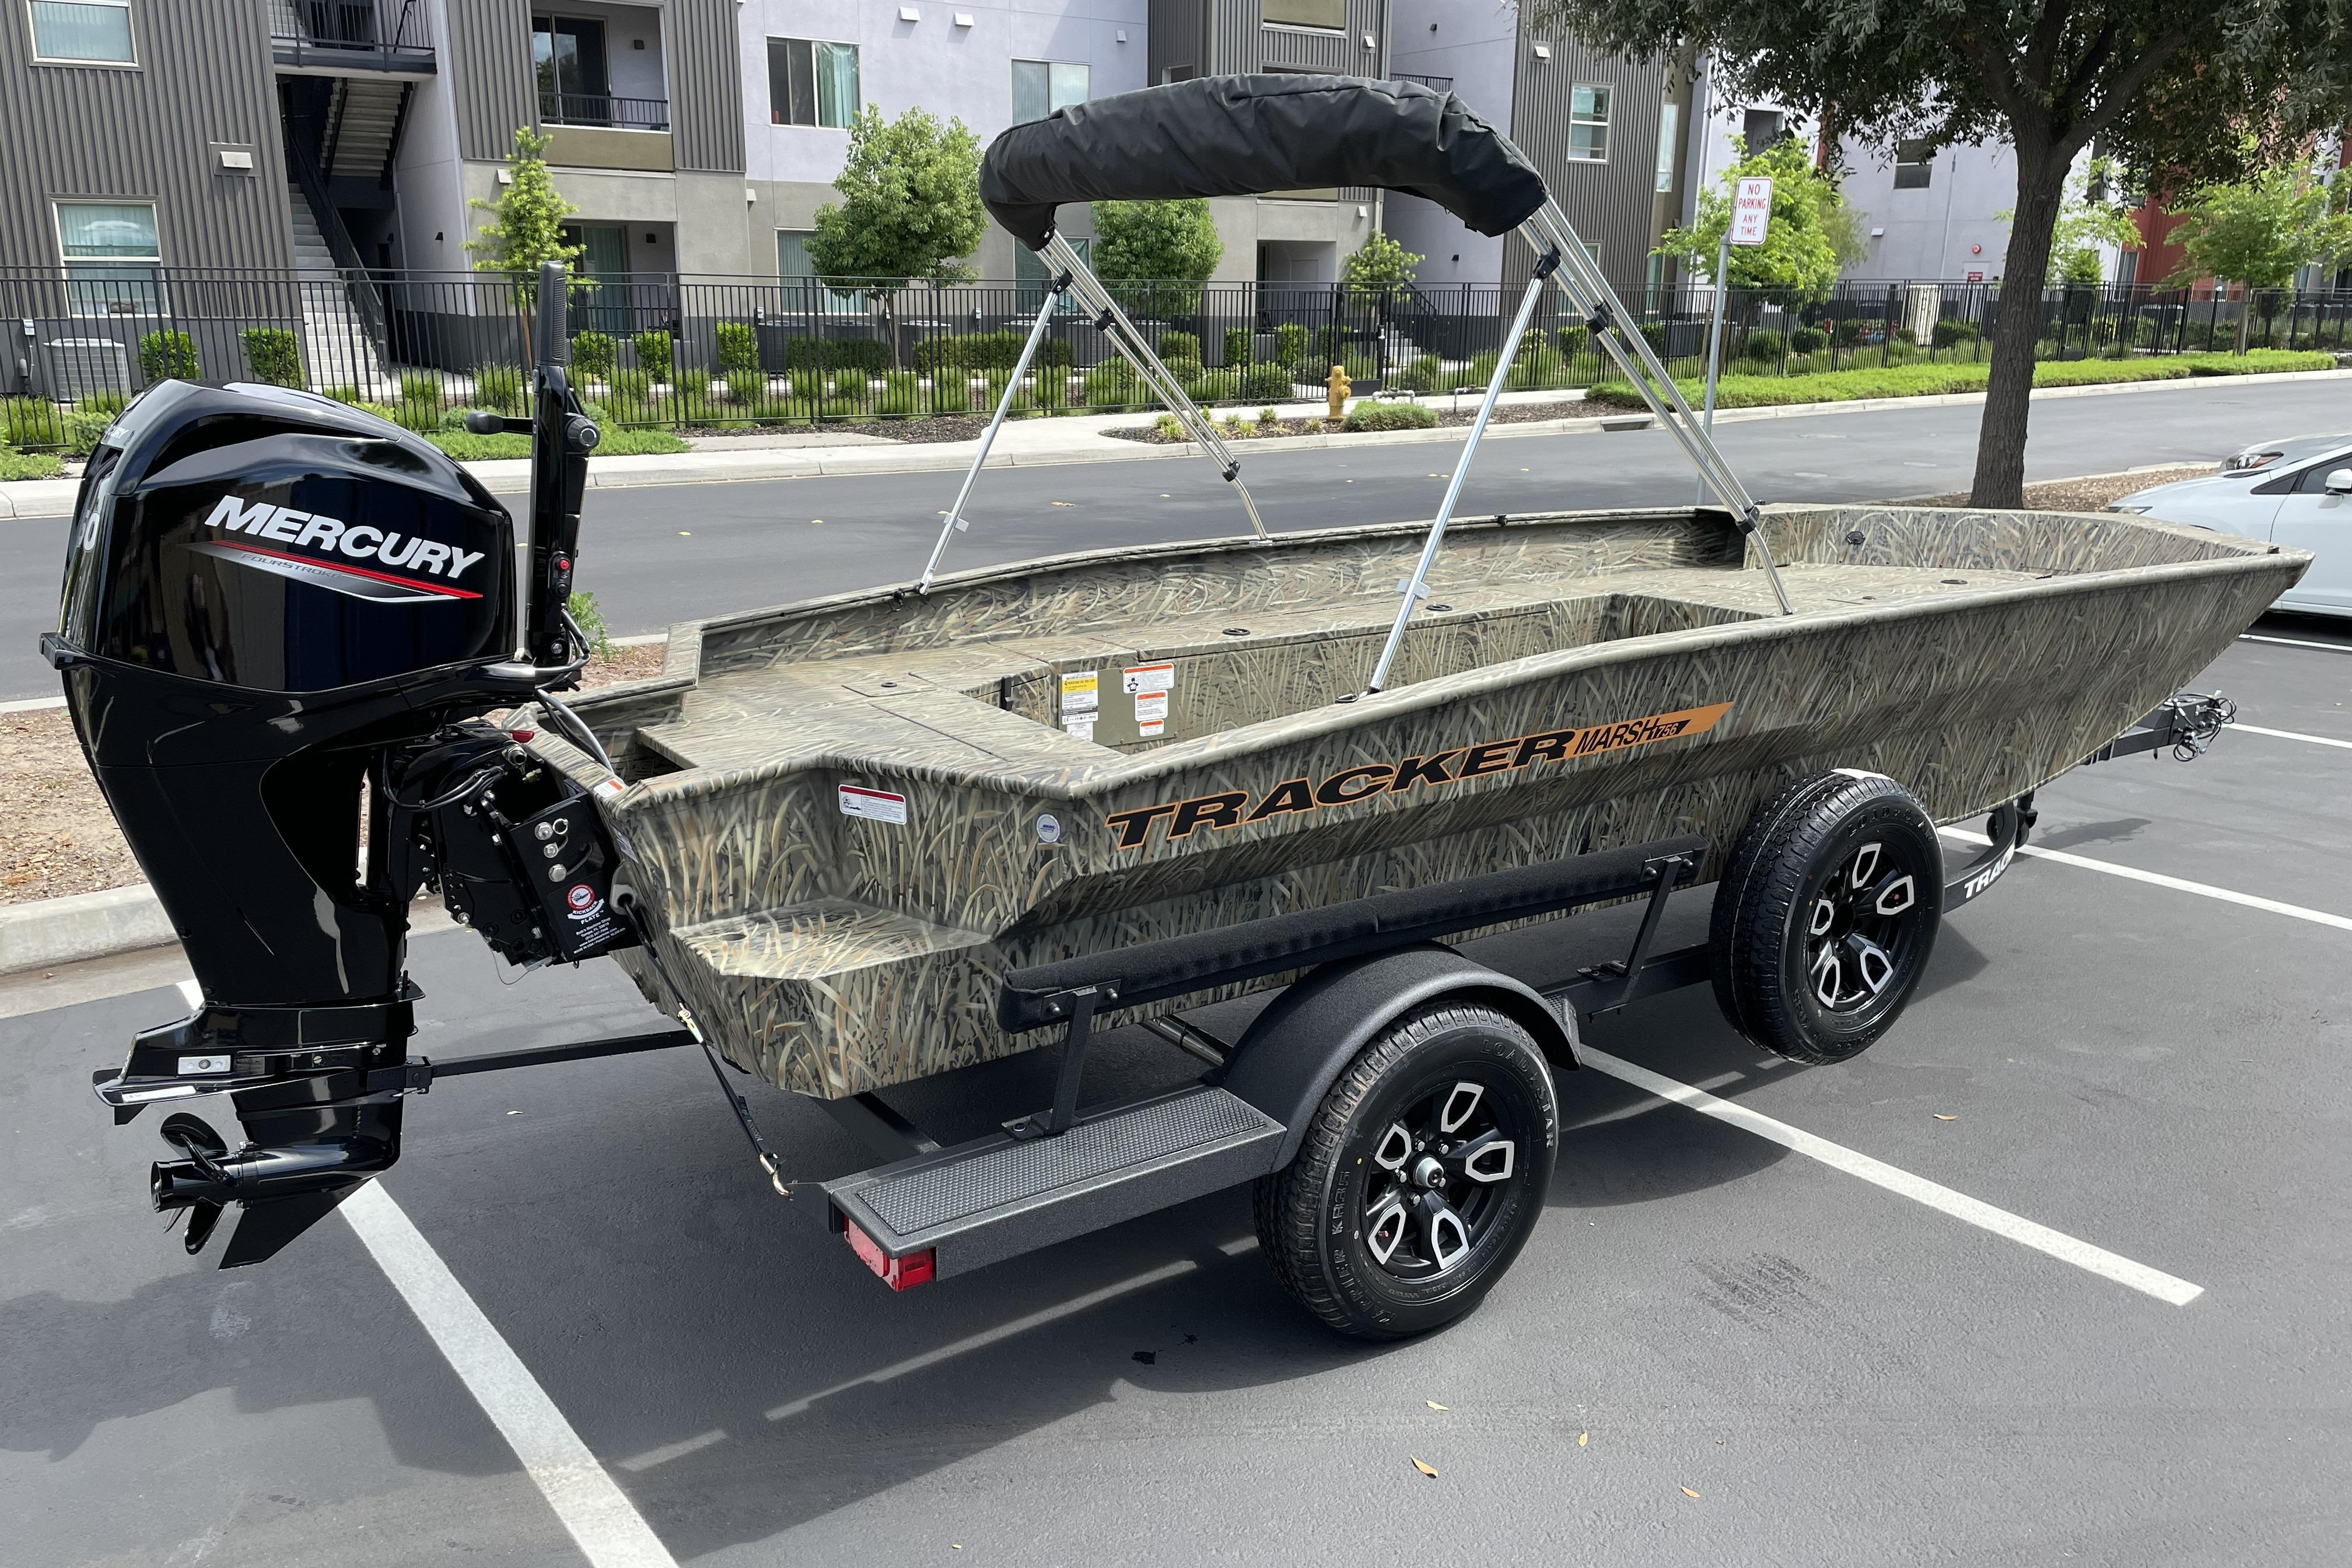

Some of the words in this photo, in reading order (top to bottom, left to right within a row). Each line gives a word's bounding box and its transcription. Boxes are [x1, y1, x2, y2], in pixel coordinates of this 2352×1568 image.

[1748, 184, 1760, 195] NO
[1738, 198, 1766, 209] PARKING
[1742, 214, 1758, 223] ANY
[1741, 226, 1758, 236] TIME
[204, 495, 485, 579] MERCURY
[240, 552, 342, 579] FOURSTROKE
[1104, 727, 1577, 850] TRACKER
[1573, 717, 1660, 755] MARSH
[1649, 723, 1679, 740] 1756
[572, 901, 598, 915] KICKBACK
[580, 912, 600, 925] PLATE
[1480, 1038, 1531, 1074] LOAD
[1535, 1086, 1555, 1149] STAR
